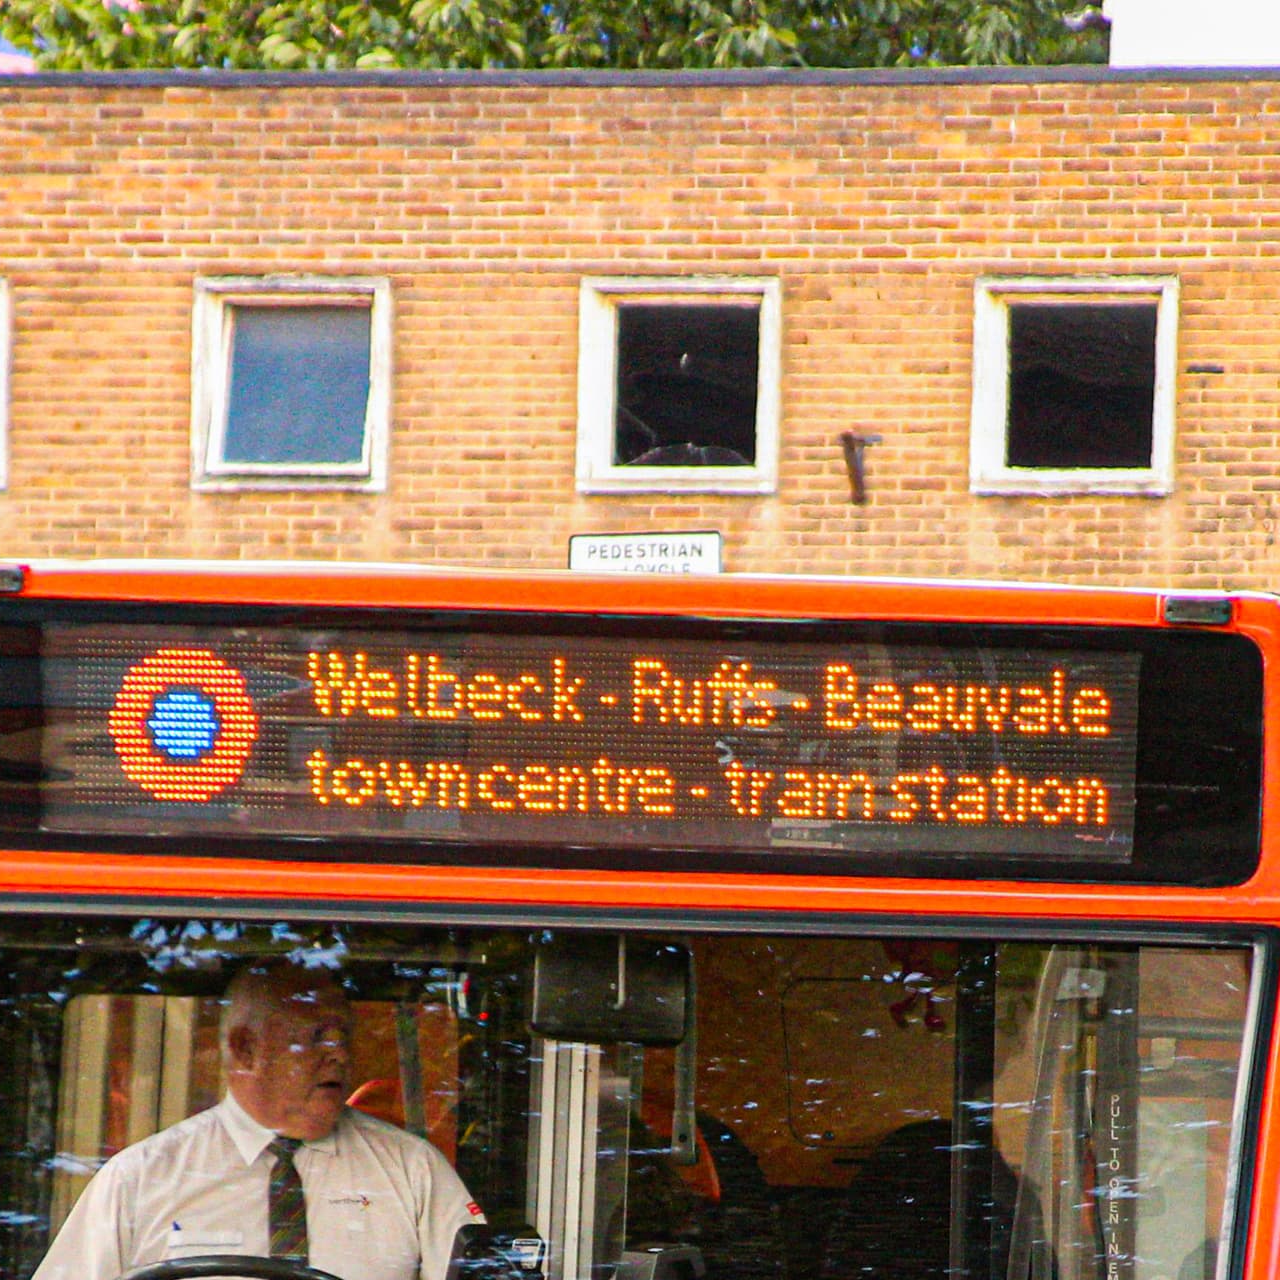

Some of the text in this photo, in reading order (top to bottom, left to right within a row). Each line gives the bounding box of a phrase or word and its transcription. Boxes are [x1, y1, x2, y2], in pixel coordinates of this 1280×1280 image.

[587, 543, 703, 559] PEDESTRIAN
[307, 651, 588, 722] Welbeck
[631, 659, 777, 726] Ruffs
[823, 663, 1112, 735] Beauvale
[306, 750, 468, 809] town
[477, 757, 676, 816] centre
[723, 760, 875, 819] tram
[888, 765, 1110, 826] station
[1111, 1094, 1120, 1140] PULL
[1109, 1147, 1120, 1171] TO
[1108, 1231, 1119, 1256] IN
